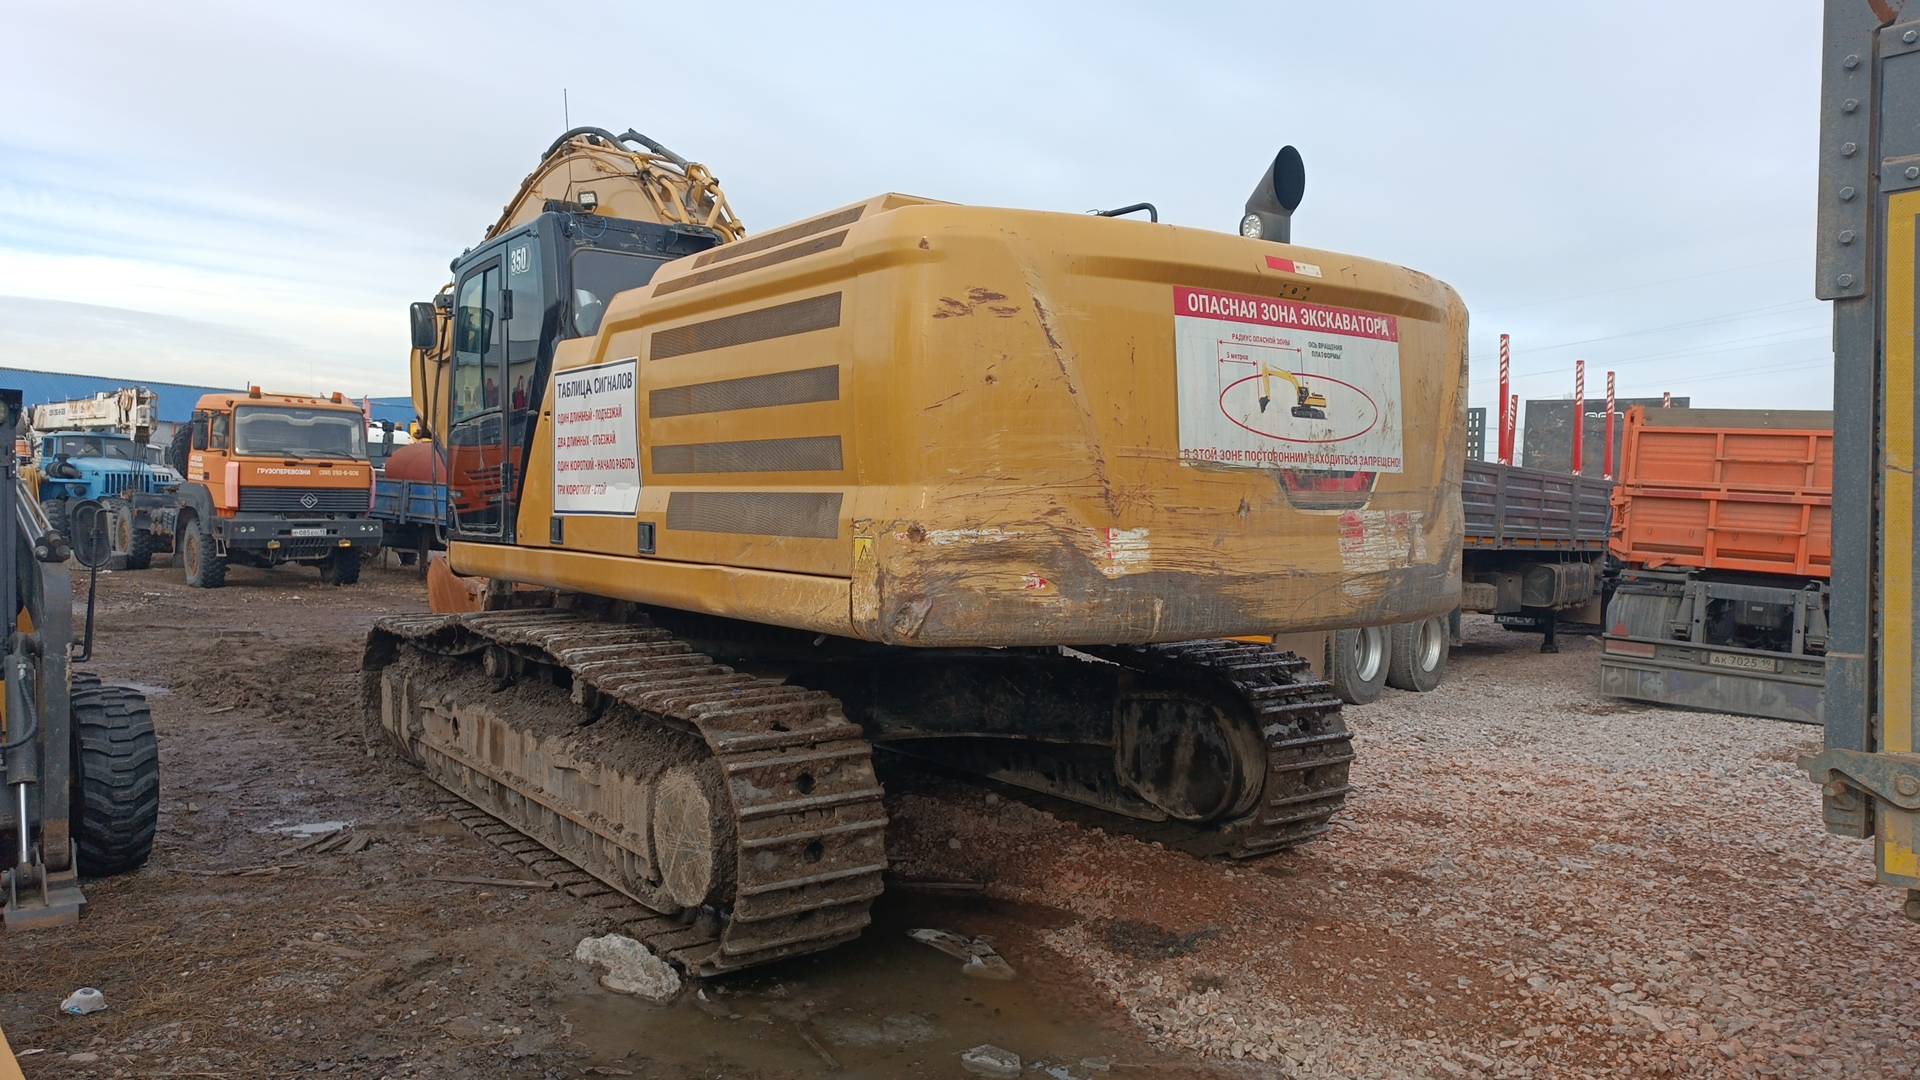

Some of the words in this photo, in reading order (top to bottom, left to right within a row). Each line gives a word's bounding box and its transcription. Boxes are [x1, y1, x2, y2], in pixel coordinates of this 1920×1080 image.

[511, 247, 528, 273] 350
[1187, 293, 1257, 319] ОПАСНАЯ
[1260, 303, 1298, 324] ЗОНА
[1300, 308, 1389, 336] ЭКСКАВАТОРА
[1232, 333, 1252, 342] РАДИУС
[1253, 335, 1276, 345] ОПАСНОЙ
[1311, 351, 1341, 360] ПЛАТФОРМЫ
[557, 379, 593, 399] ТАБЛИЦА
[594, 372, 633, 394] СИГНАЛОВ
[557, 413, 569, 425] ОДИН
[570, 408, 593, 425] ДЛИННЫЙ
[570, 457, 594, 471] КОРОТКИЙ
[597, 459, 615, 471] НАЧАЛО
[616, 458, 636, 470] РАБОТЫ
[1183, 449, 1189, 459] В
[1193, 447, 1217, 461] ЭТОЙ
[1219, 450, 1243, 462] ЗОНЕ
[1244, 450, 1308, 464] ПОСТОРОННИМ
[1309, 452, 1358, 466] НАХОДИТЬСЯ
[1728, 656, 1758, 668] 7025
